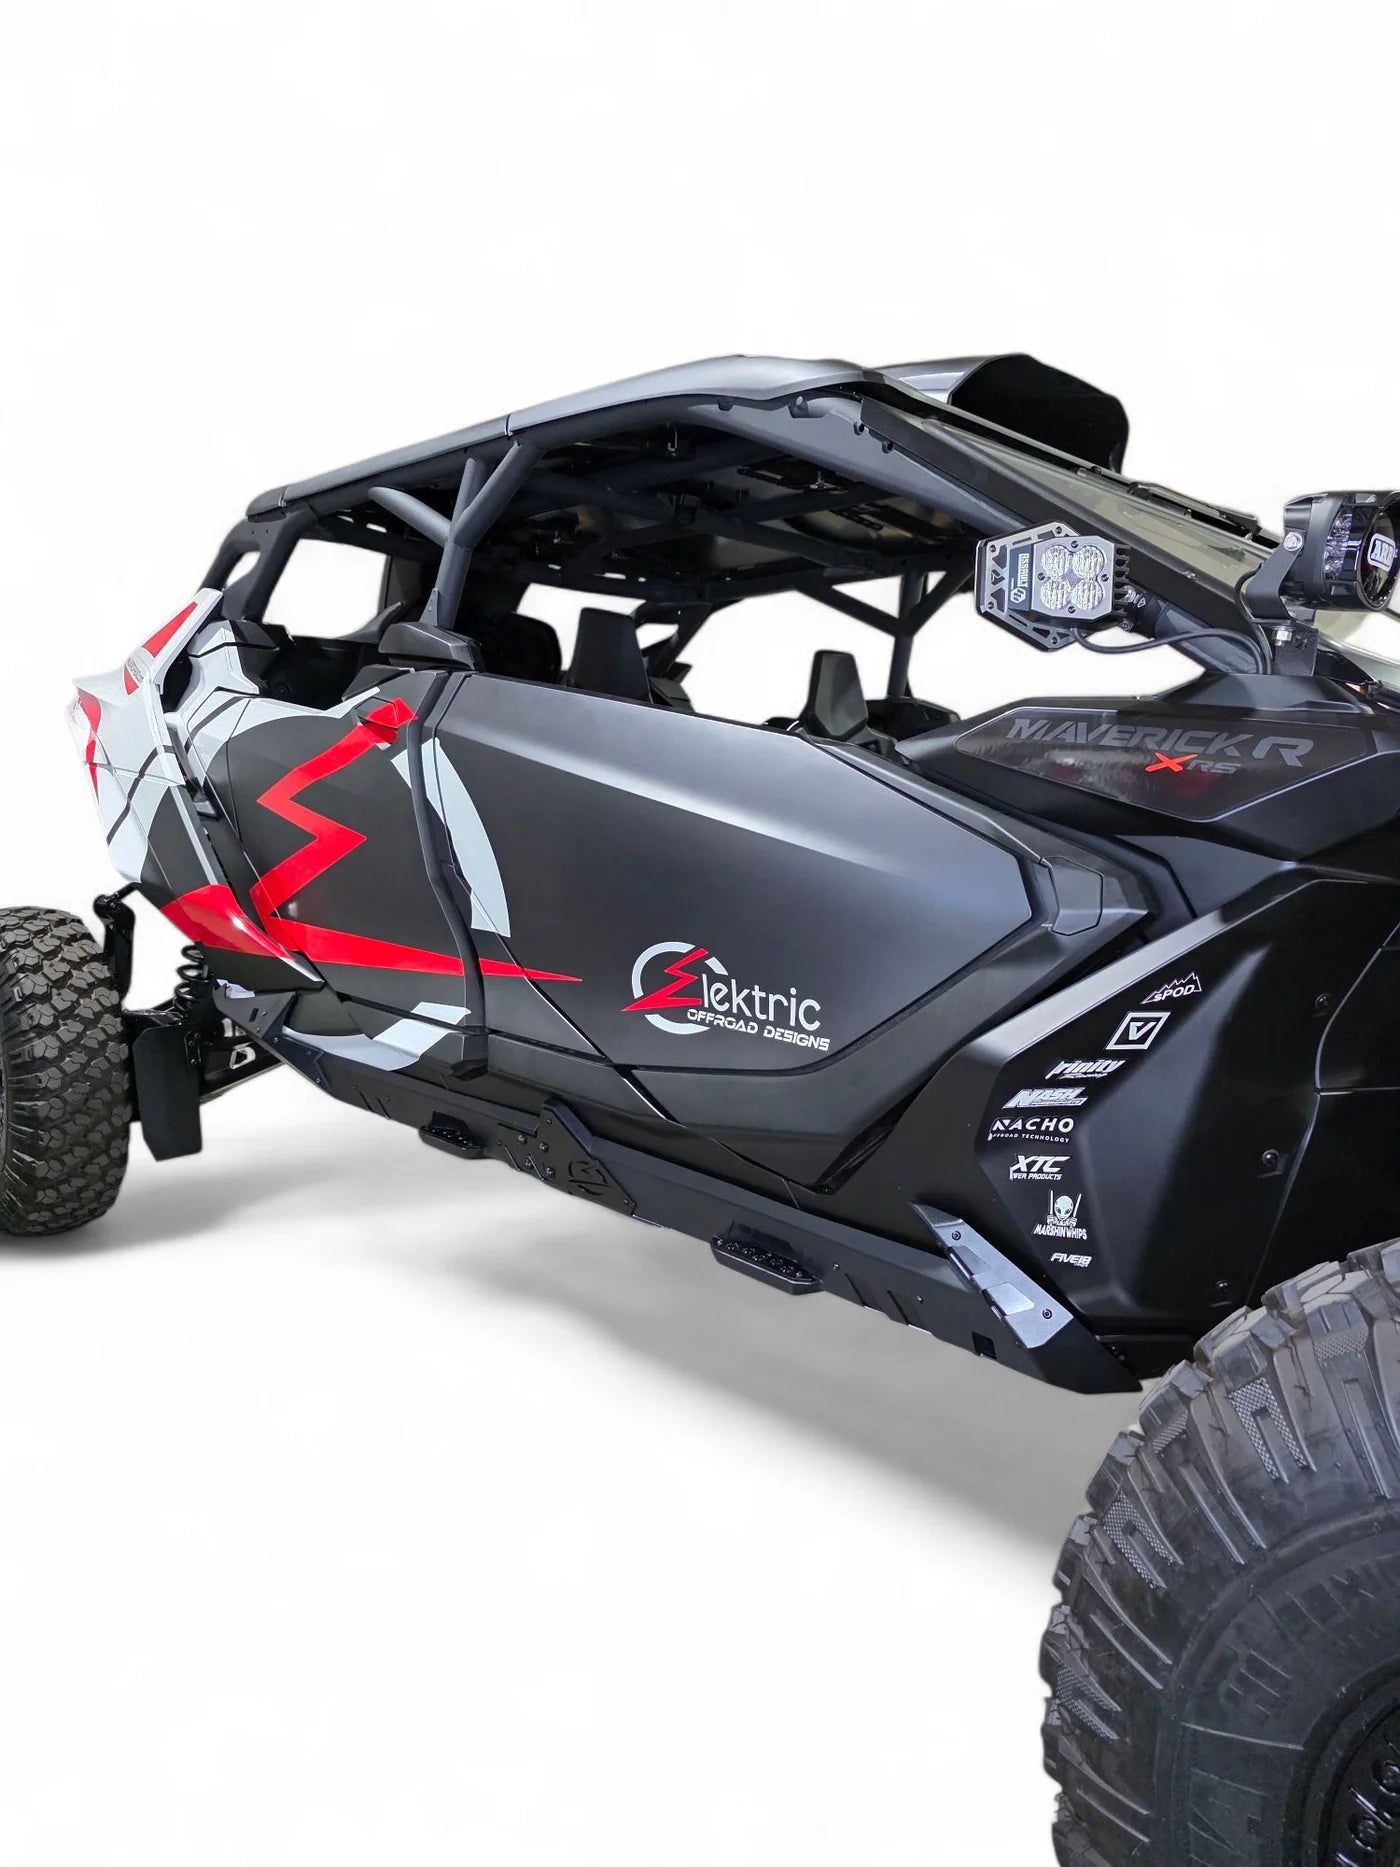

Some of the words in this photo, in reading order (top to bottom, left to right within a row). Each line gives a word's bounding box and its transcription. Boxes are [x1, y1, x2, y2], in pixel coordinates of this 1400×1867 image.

[1006, 718, 1253, 757] MAVERICK
[1251, 735, 1314, 767] R
[686, 1008, 758, 1034] OFFROAD
[763, 1025, 831, 1051] DESIGNS
[992, 1117, 1074, 1133] NACHO
[1021, 1133, 1070, 1143] TECHNOLOGY
[1009, 1155, 1071, 1172] XTC
[1027, 1172, 1062, 1181] PRODUCTS
